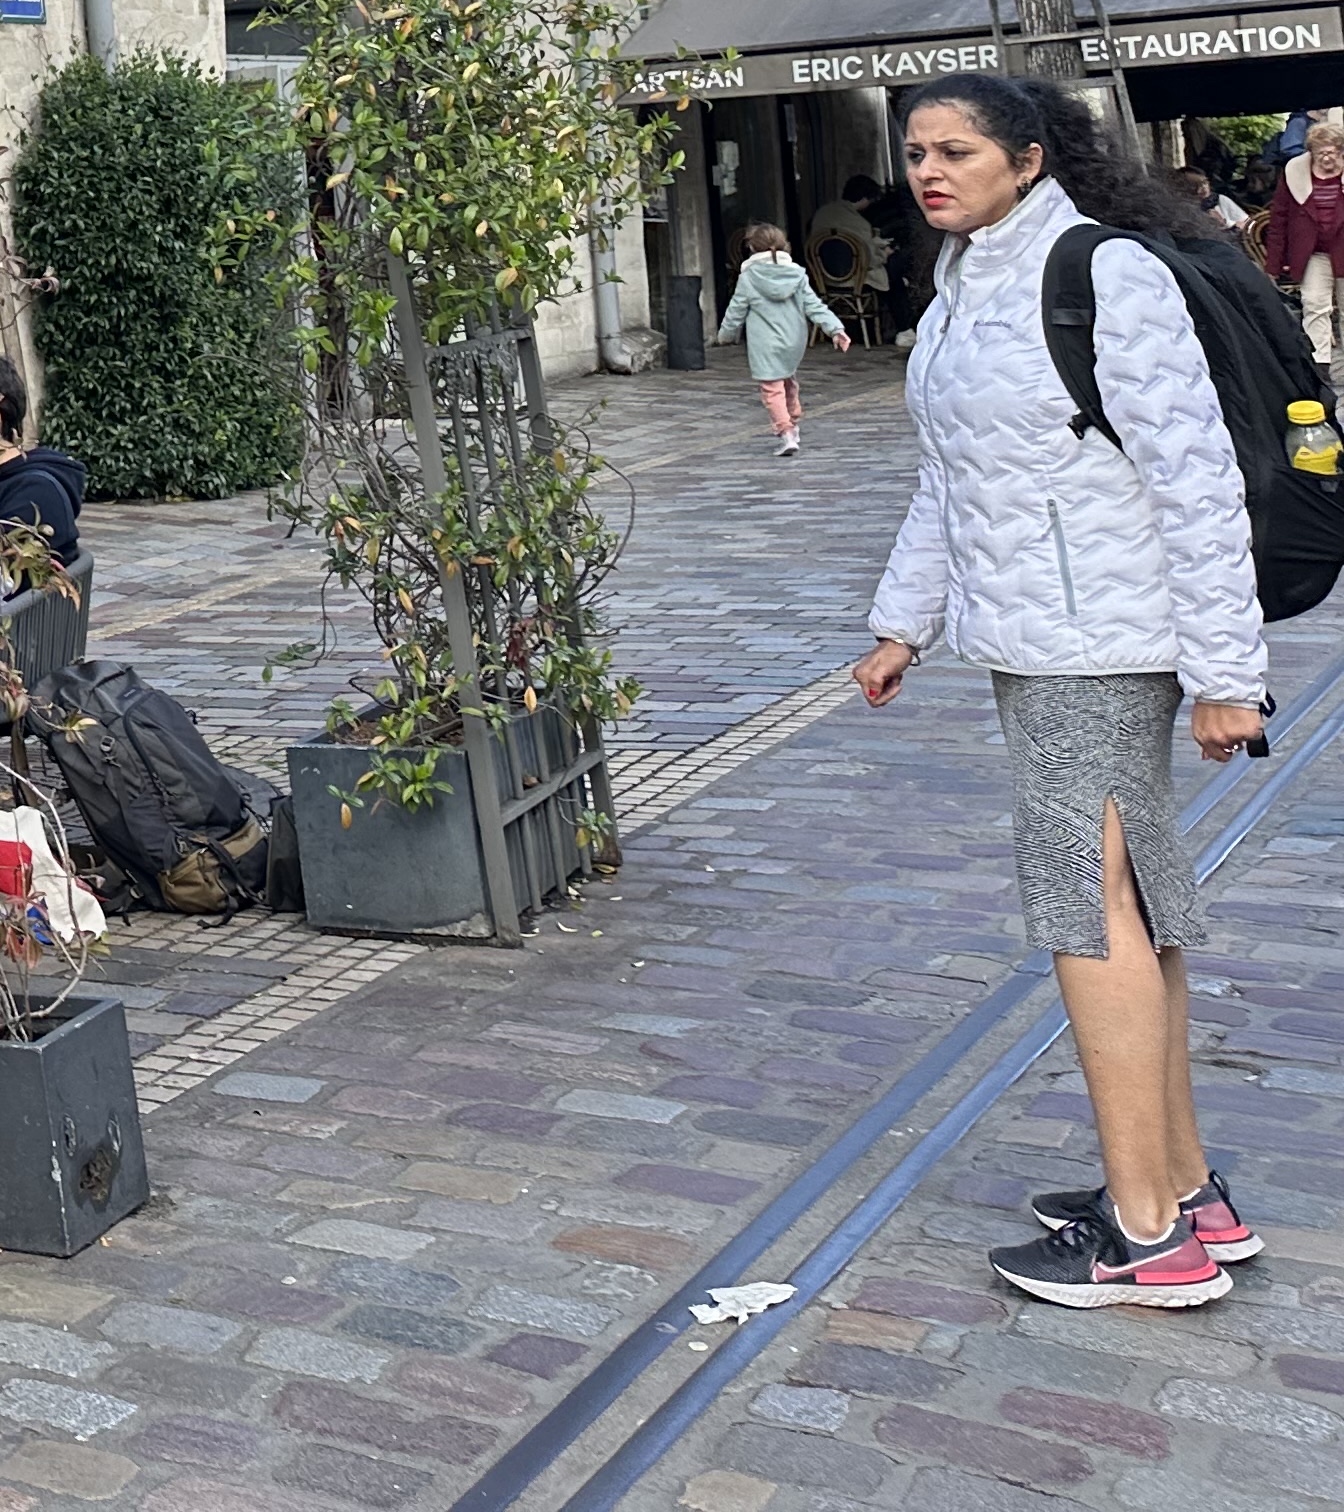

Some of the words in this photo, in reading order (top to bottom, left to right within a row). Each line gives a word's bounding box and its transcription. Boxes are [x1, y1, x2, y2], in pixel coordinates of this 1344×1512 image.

[630, 67, 744, 93] ARTISAN
[792, 55, 864, 83] ERIC
[872, 44, 999, 78] KAYSER
[1080, 24, 1321, 62] ESTAURATION
